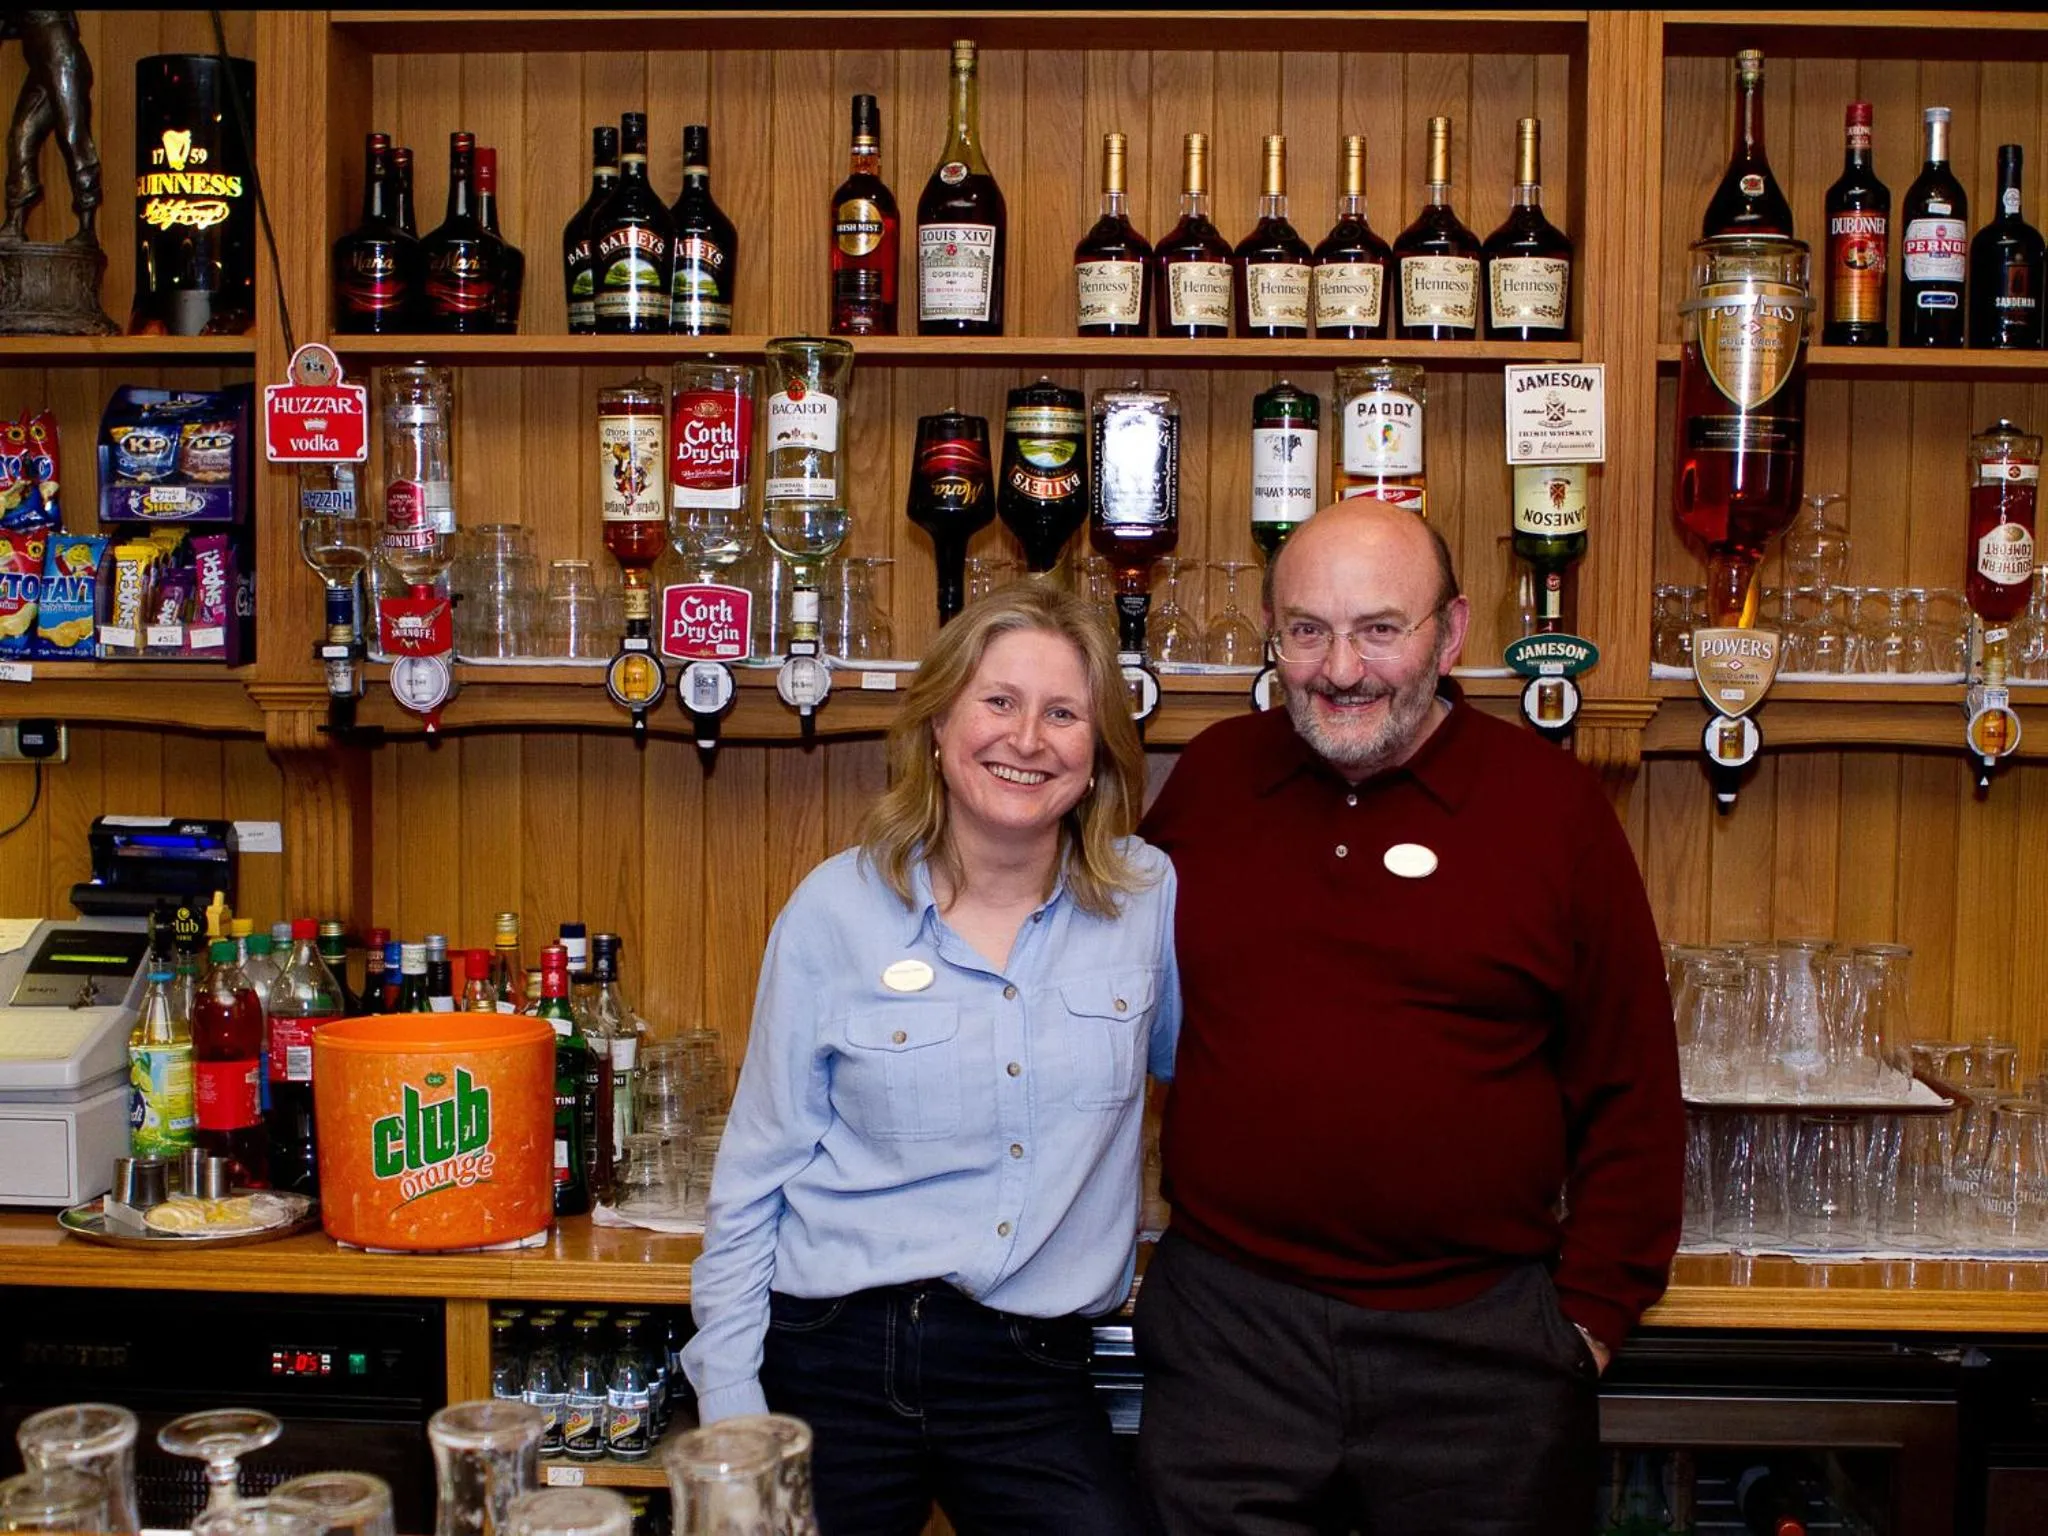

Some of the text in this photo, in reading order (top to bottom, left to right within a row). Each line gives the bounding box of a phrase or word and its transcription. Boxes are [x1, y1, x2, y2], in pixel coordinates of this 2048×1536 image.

[152, 148, 208, 165] 17 59
[922, 230, 990, 243] LOUIS XIV
[1080, 280, 1129, 294] Hennessy
[1320, 283, 1370, 296] Hennessy
[1414, 276, 1471, 293] Hennessy
[1503, 278, 1560, 294] Hennessy
[1516, 371, 1595, 393] JAMESON
[273, 396, 362, 415] HUZZAR
[772, 403, 827, 415] BACARDI
[1357, 402, 1415, 417] PADDY
[684, 419, 733, 446] Cork
[129, 437, 167, 452] KP
[290, 434, 340, 452] vodka
[677, 441, 740, 465] Dry Gin
[1012, 472, 1081, 496] BAILEYS
[1523, 506, 1586, 527] JAMESON
[1985, 543, 2032, 557] COMFORT
[681, 595, 734, 624] Cork
[671, 619, 740, 646] Dry Gin
[1516, 642, 1589, 662] JAMESON
[1701, 638, 1773, 660] POWERS
[373, 1068, 491, 1178] club
[402, 1154, 494, 1199] orange
